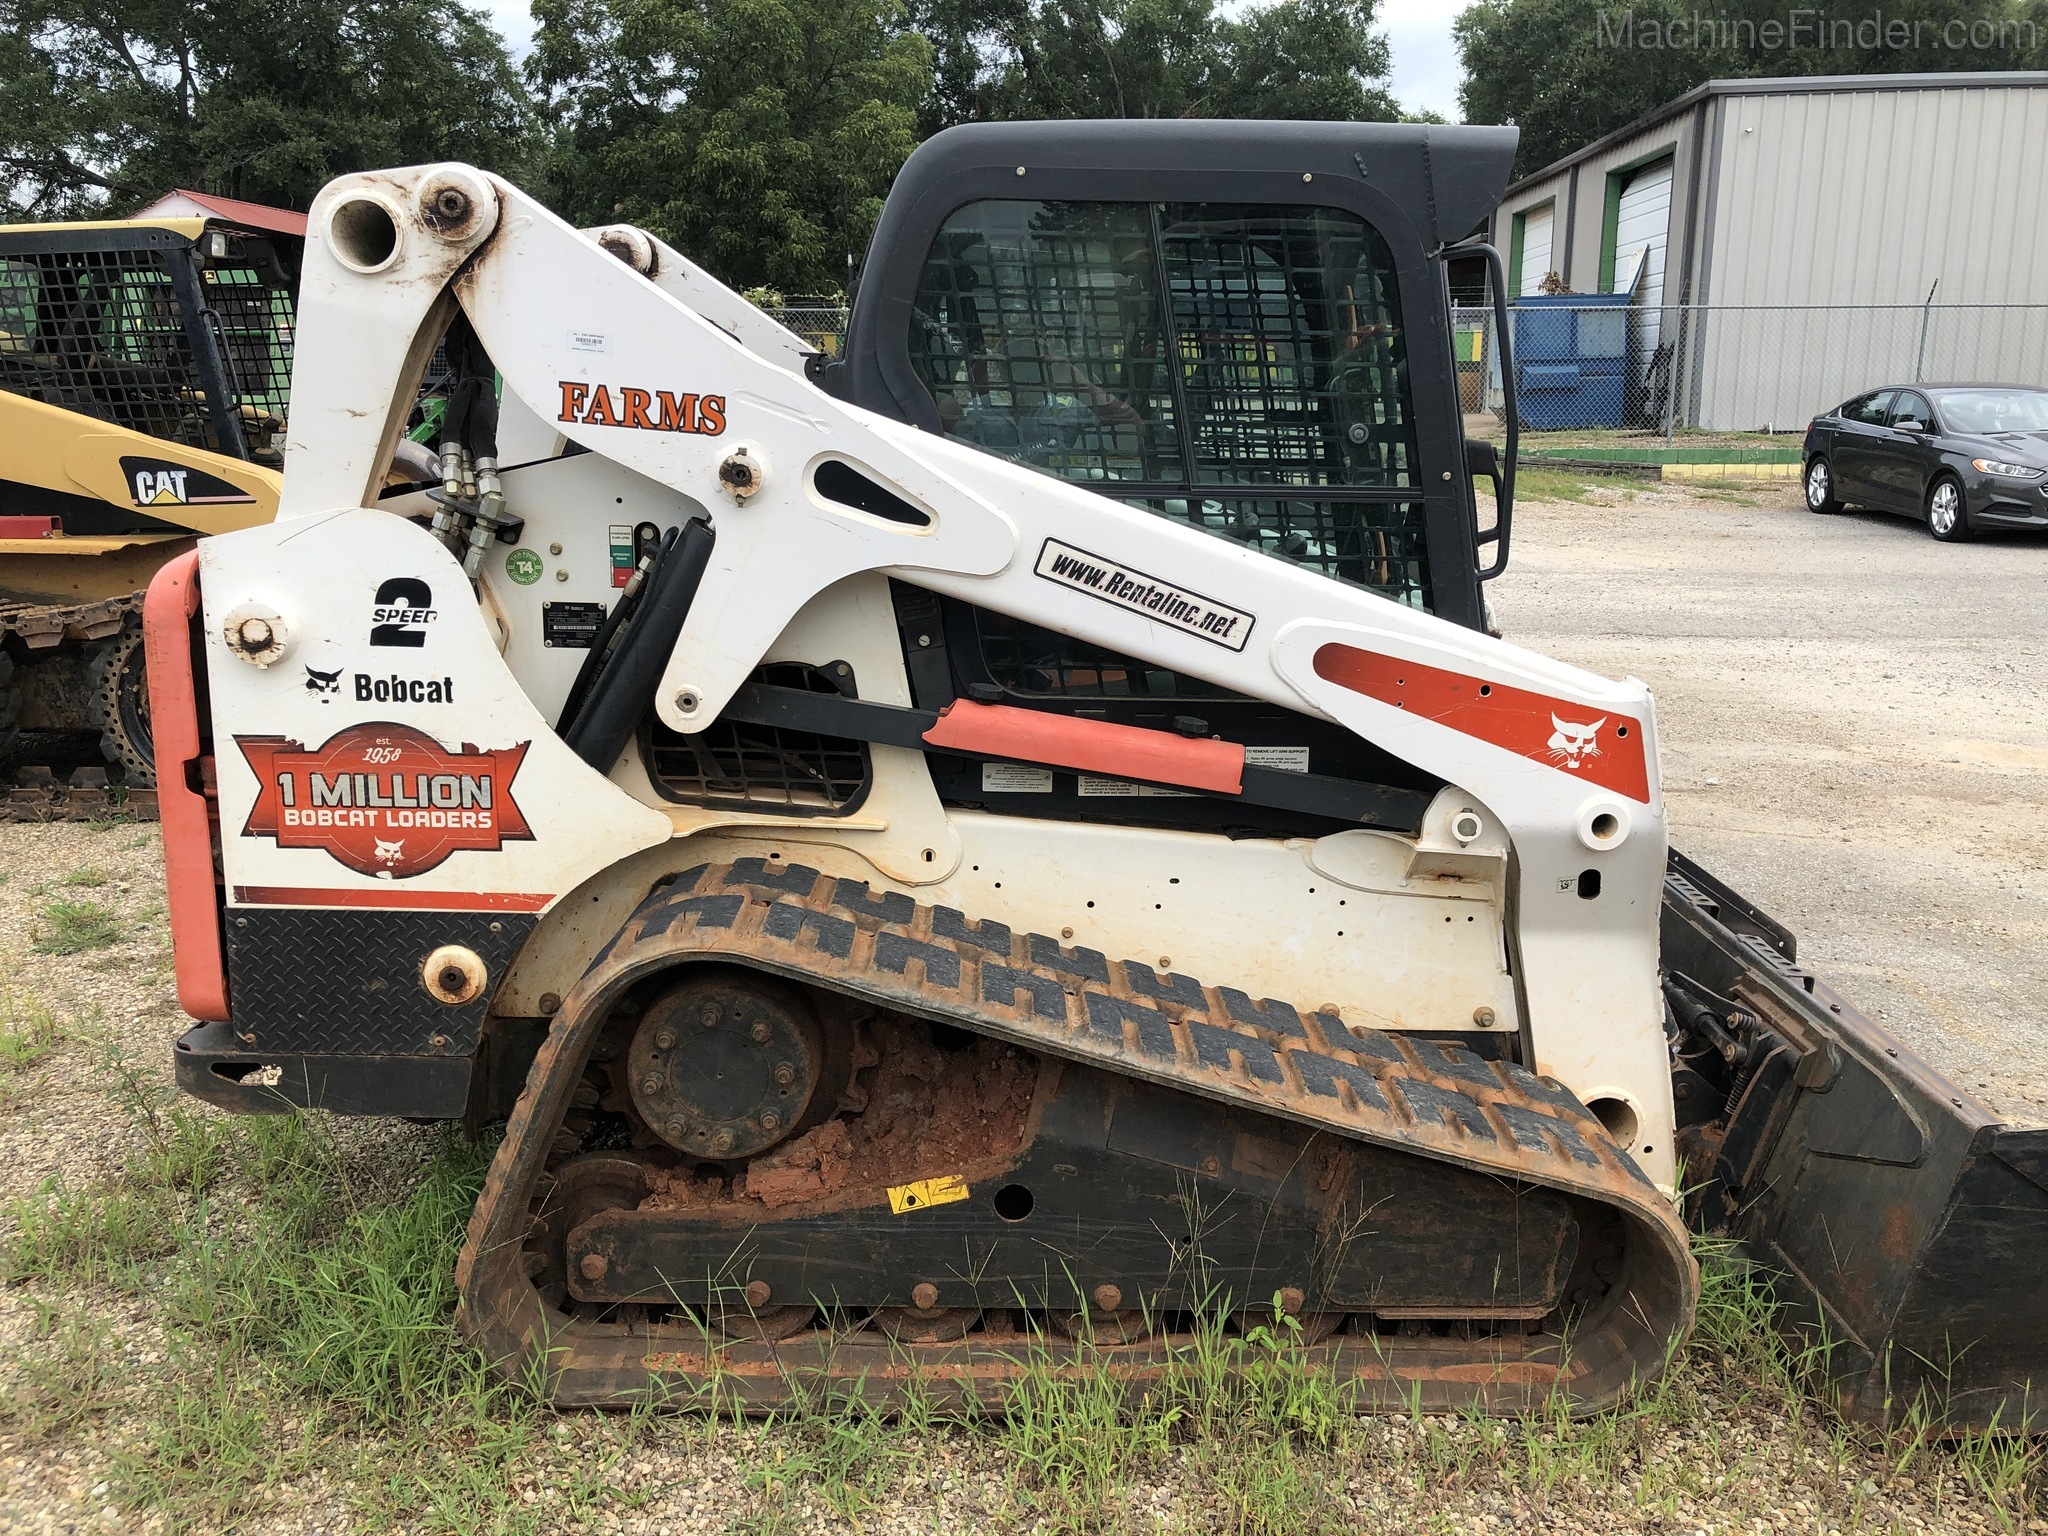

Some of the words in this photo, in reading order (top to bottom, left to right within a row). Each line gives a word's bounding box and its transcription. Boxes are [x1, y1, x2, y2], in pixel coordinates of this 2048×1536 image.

[558, 380, 728, 437] FARMS
[135, 470, 188, 504] CAT
[516, 561, 534, 574] T4
[1051, 553, 1238, 638] www.Rentalinc.net
[369, 577, 433, 648] 2
[354, 673, 454, 704] Bobcat
[362, 747, 402, 765] 1958
[375, 737, 392, 746] est.
[277, 771, 296, 808] 1
[308, 771, 493, 810] MILLION
[284, 809, 379, 827] BOBCAT
[386, 810, 493, 829] LOADERS
